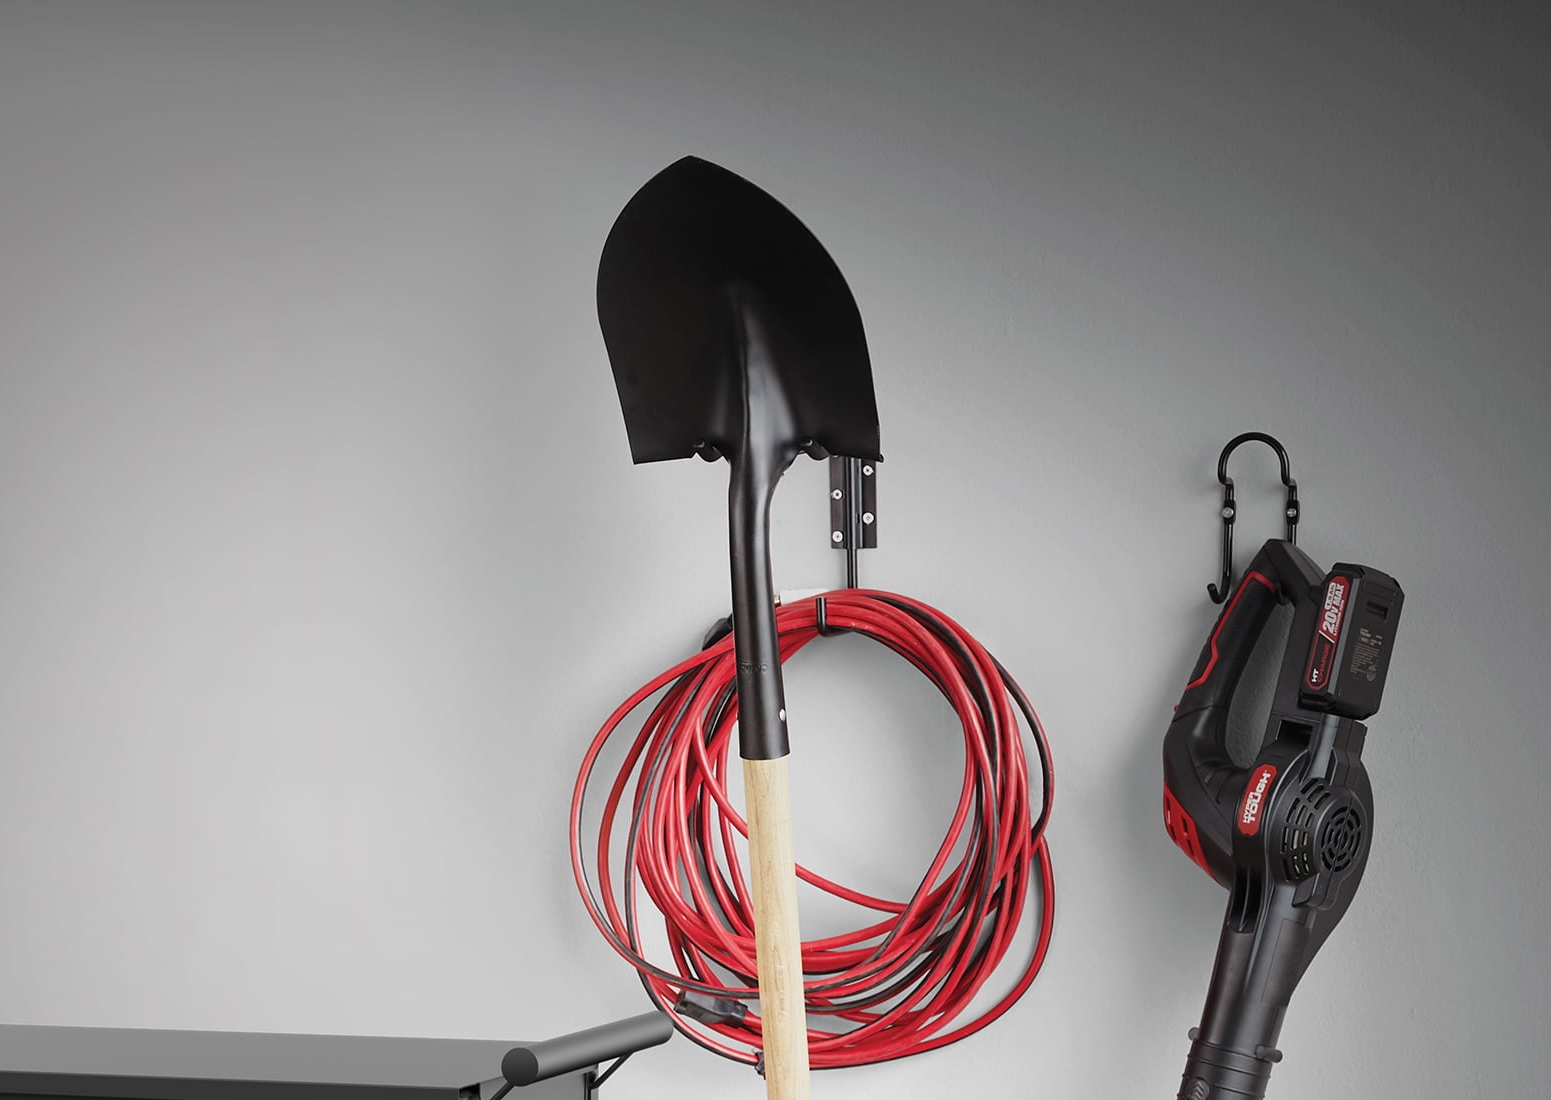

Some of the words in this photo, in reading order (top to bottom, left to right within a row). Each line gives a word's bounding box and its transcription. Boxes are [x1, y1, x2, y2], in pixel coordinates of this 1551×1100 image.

[1335, 583, 1345, 606] MAX
[1311, 668, 1319, 683] HT
[1317, 644, 1331, 683] CHARGE
[1242, 791, 1255, 824] HYPER
[1247, 772, 1271, 823] TOUGH
